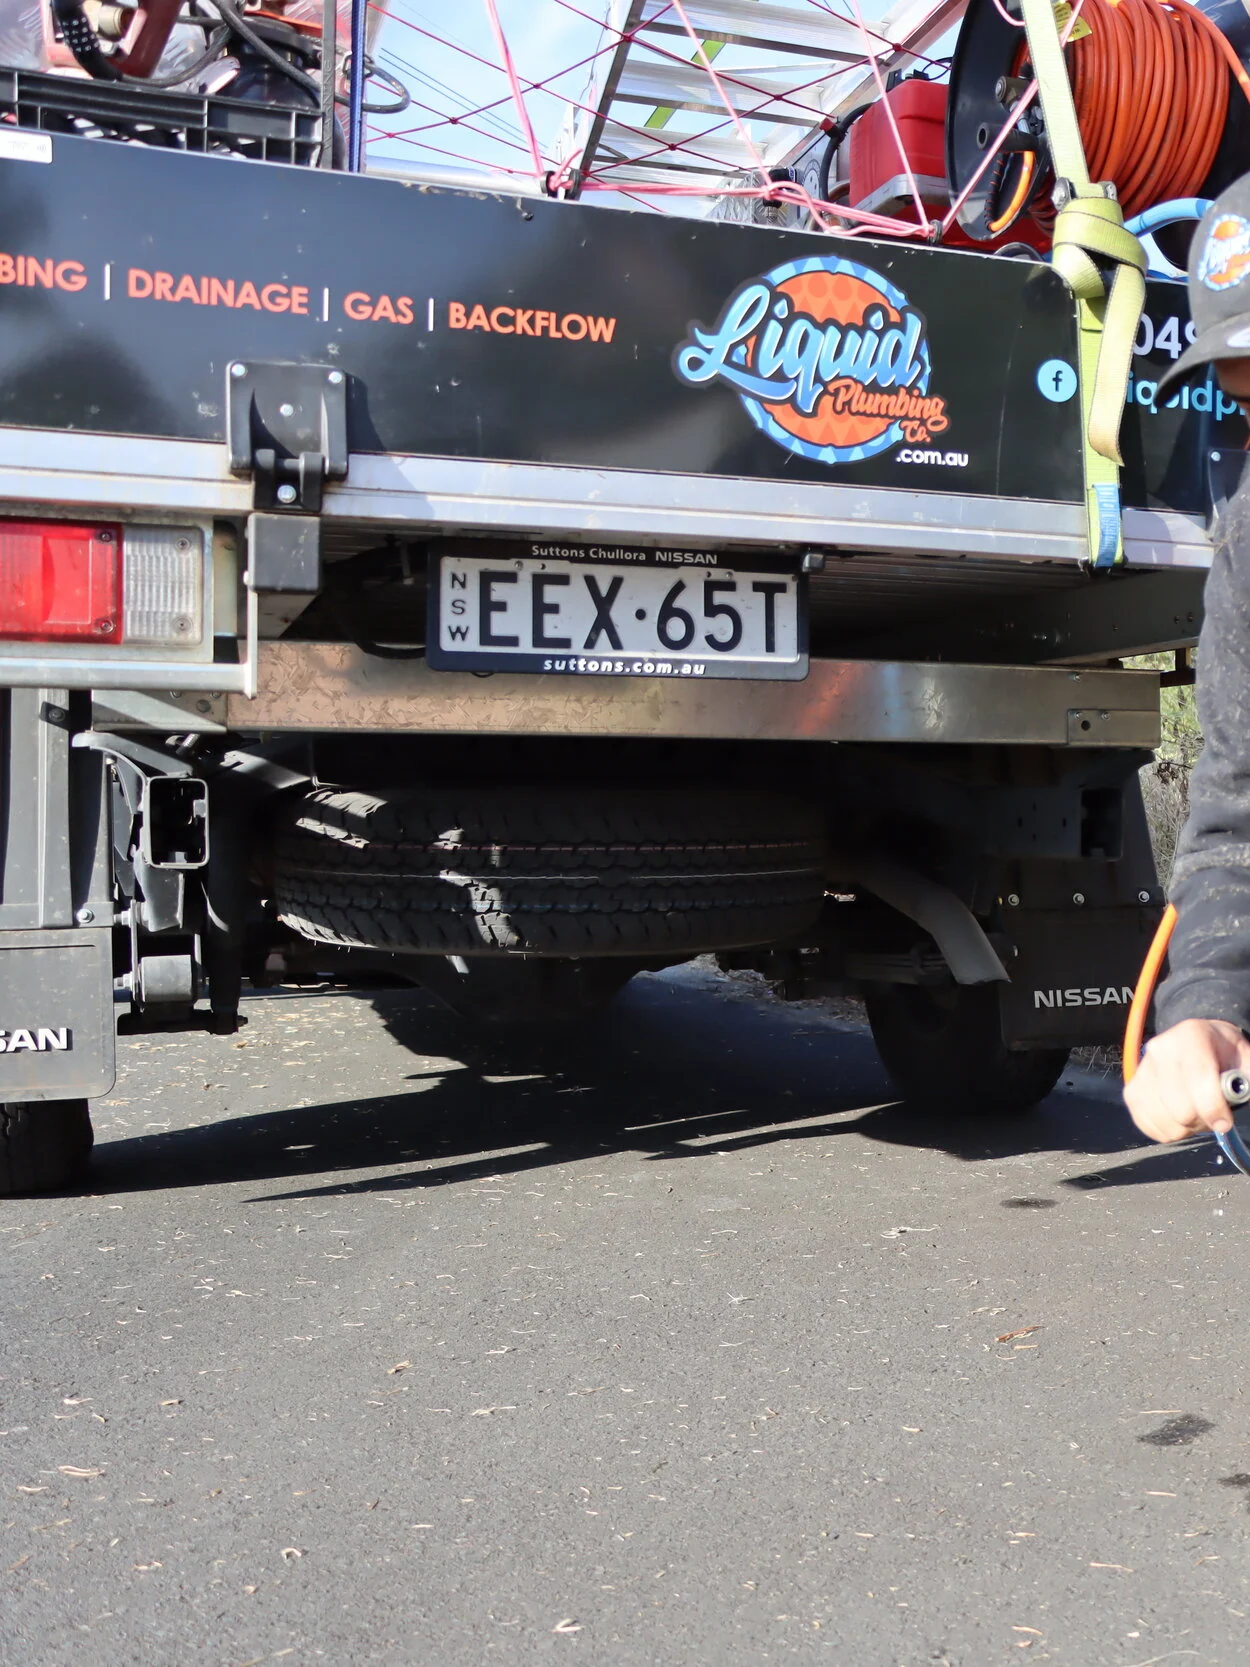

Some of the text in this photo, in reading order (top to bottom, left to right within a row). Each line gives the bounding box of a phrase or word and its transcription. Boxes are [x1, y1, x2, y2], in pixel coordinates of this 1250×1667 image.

[0, 254, 616, 343] BING DRAINAGE GAS BACKFLOW
[678, 284, 922, 413] Liquid
[827, 378, 949, 432] Plumbing
[900, 420, 932, 442] Co.
[895, 448, 969, 466] .com.au
[531, 545, 718, 565] Suttons Chullora NISSAN
[543, 657, 706, 676] suttons.com.au
